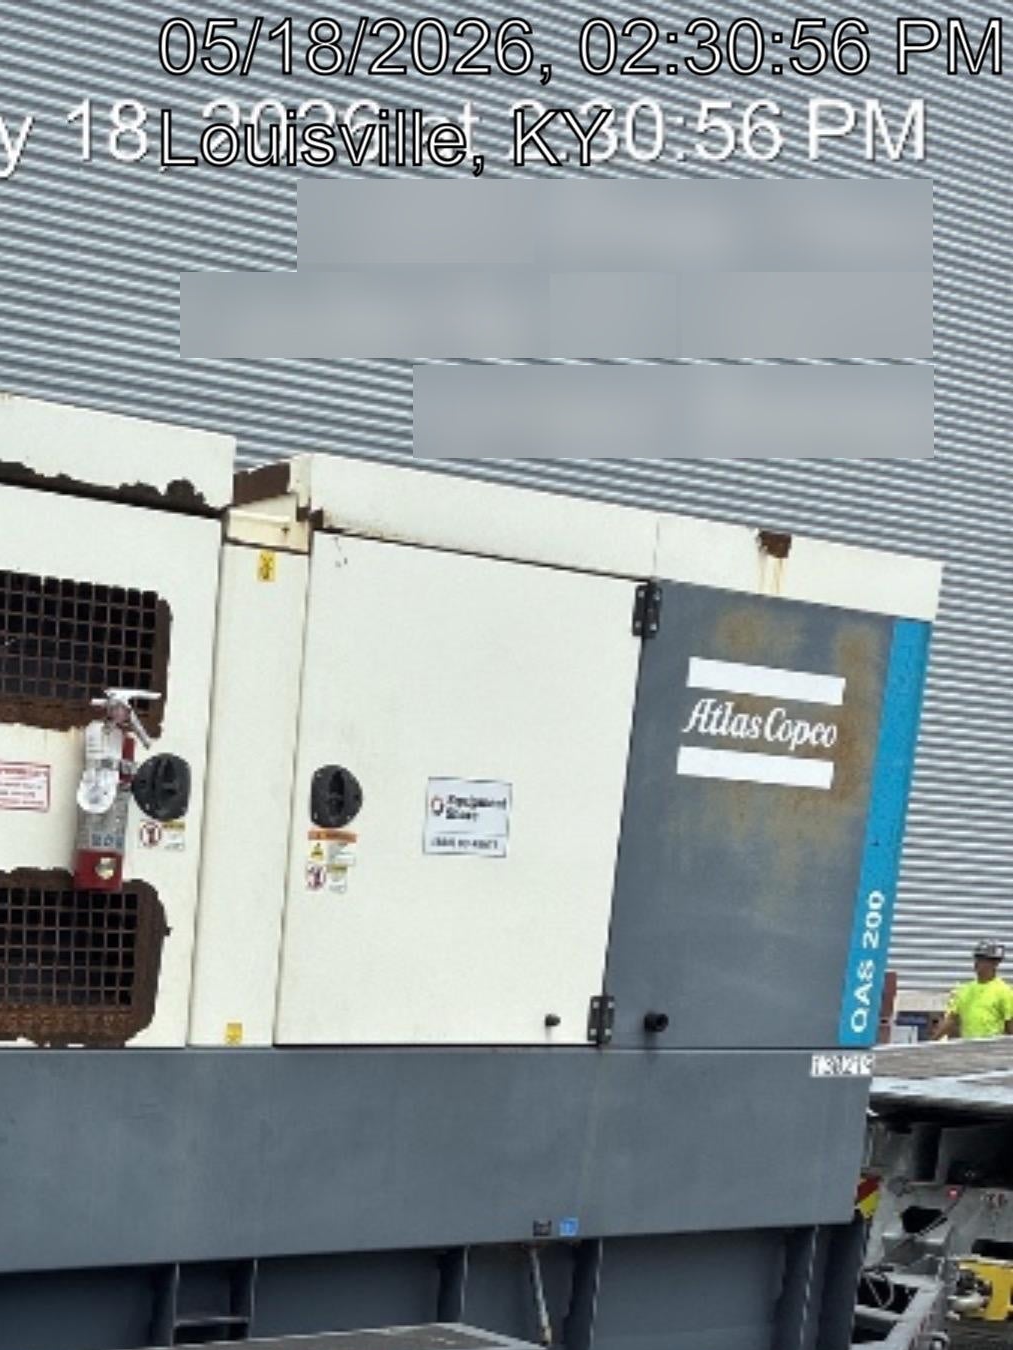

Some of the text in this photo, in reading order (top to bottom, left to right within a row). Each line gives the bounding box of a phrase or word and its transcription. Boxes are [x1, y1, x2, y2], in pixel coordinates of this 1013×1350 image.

[682, 698, 838, 751] Atlas Copco
[862, 890, 886, 950] 200
